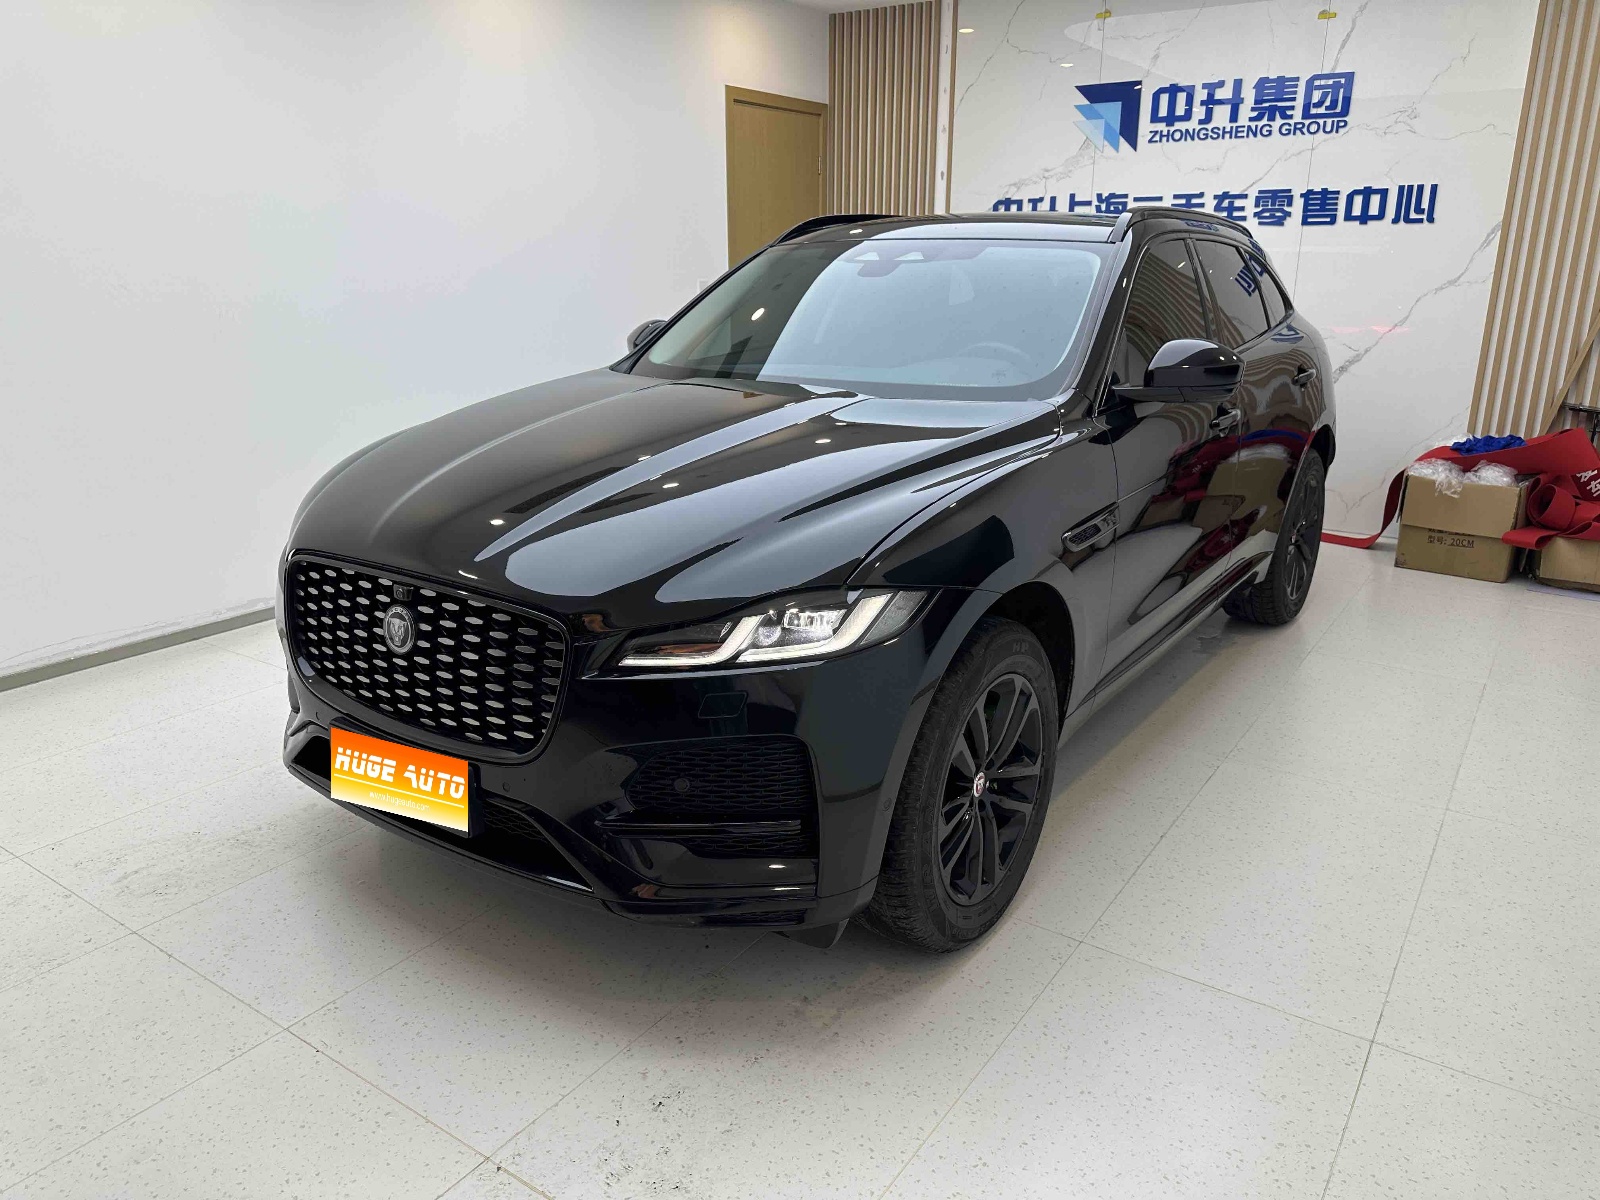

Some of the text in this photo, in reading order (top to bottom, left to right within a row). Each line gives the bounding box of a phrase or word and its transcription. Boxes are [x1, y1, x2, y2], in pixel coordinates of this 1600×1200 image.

[1150, 72, 1355, 127] 中升集团
[1148, 119, 1348, 144] ZHONGSHENG GROUP
